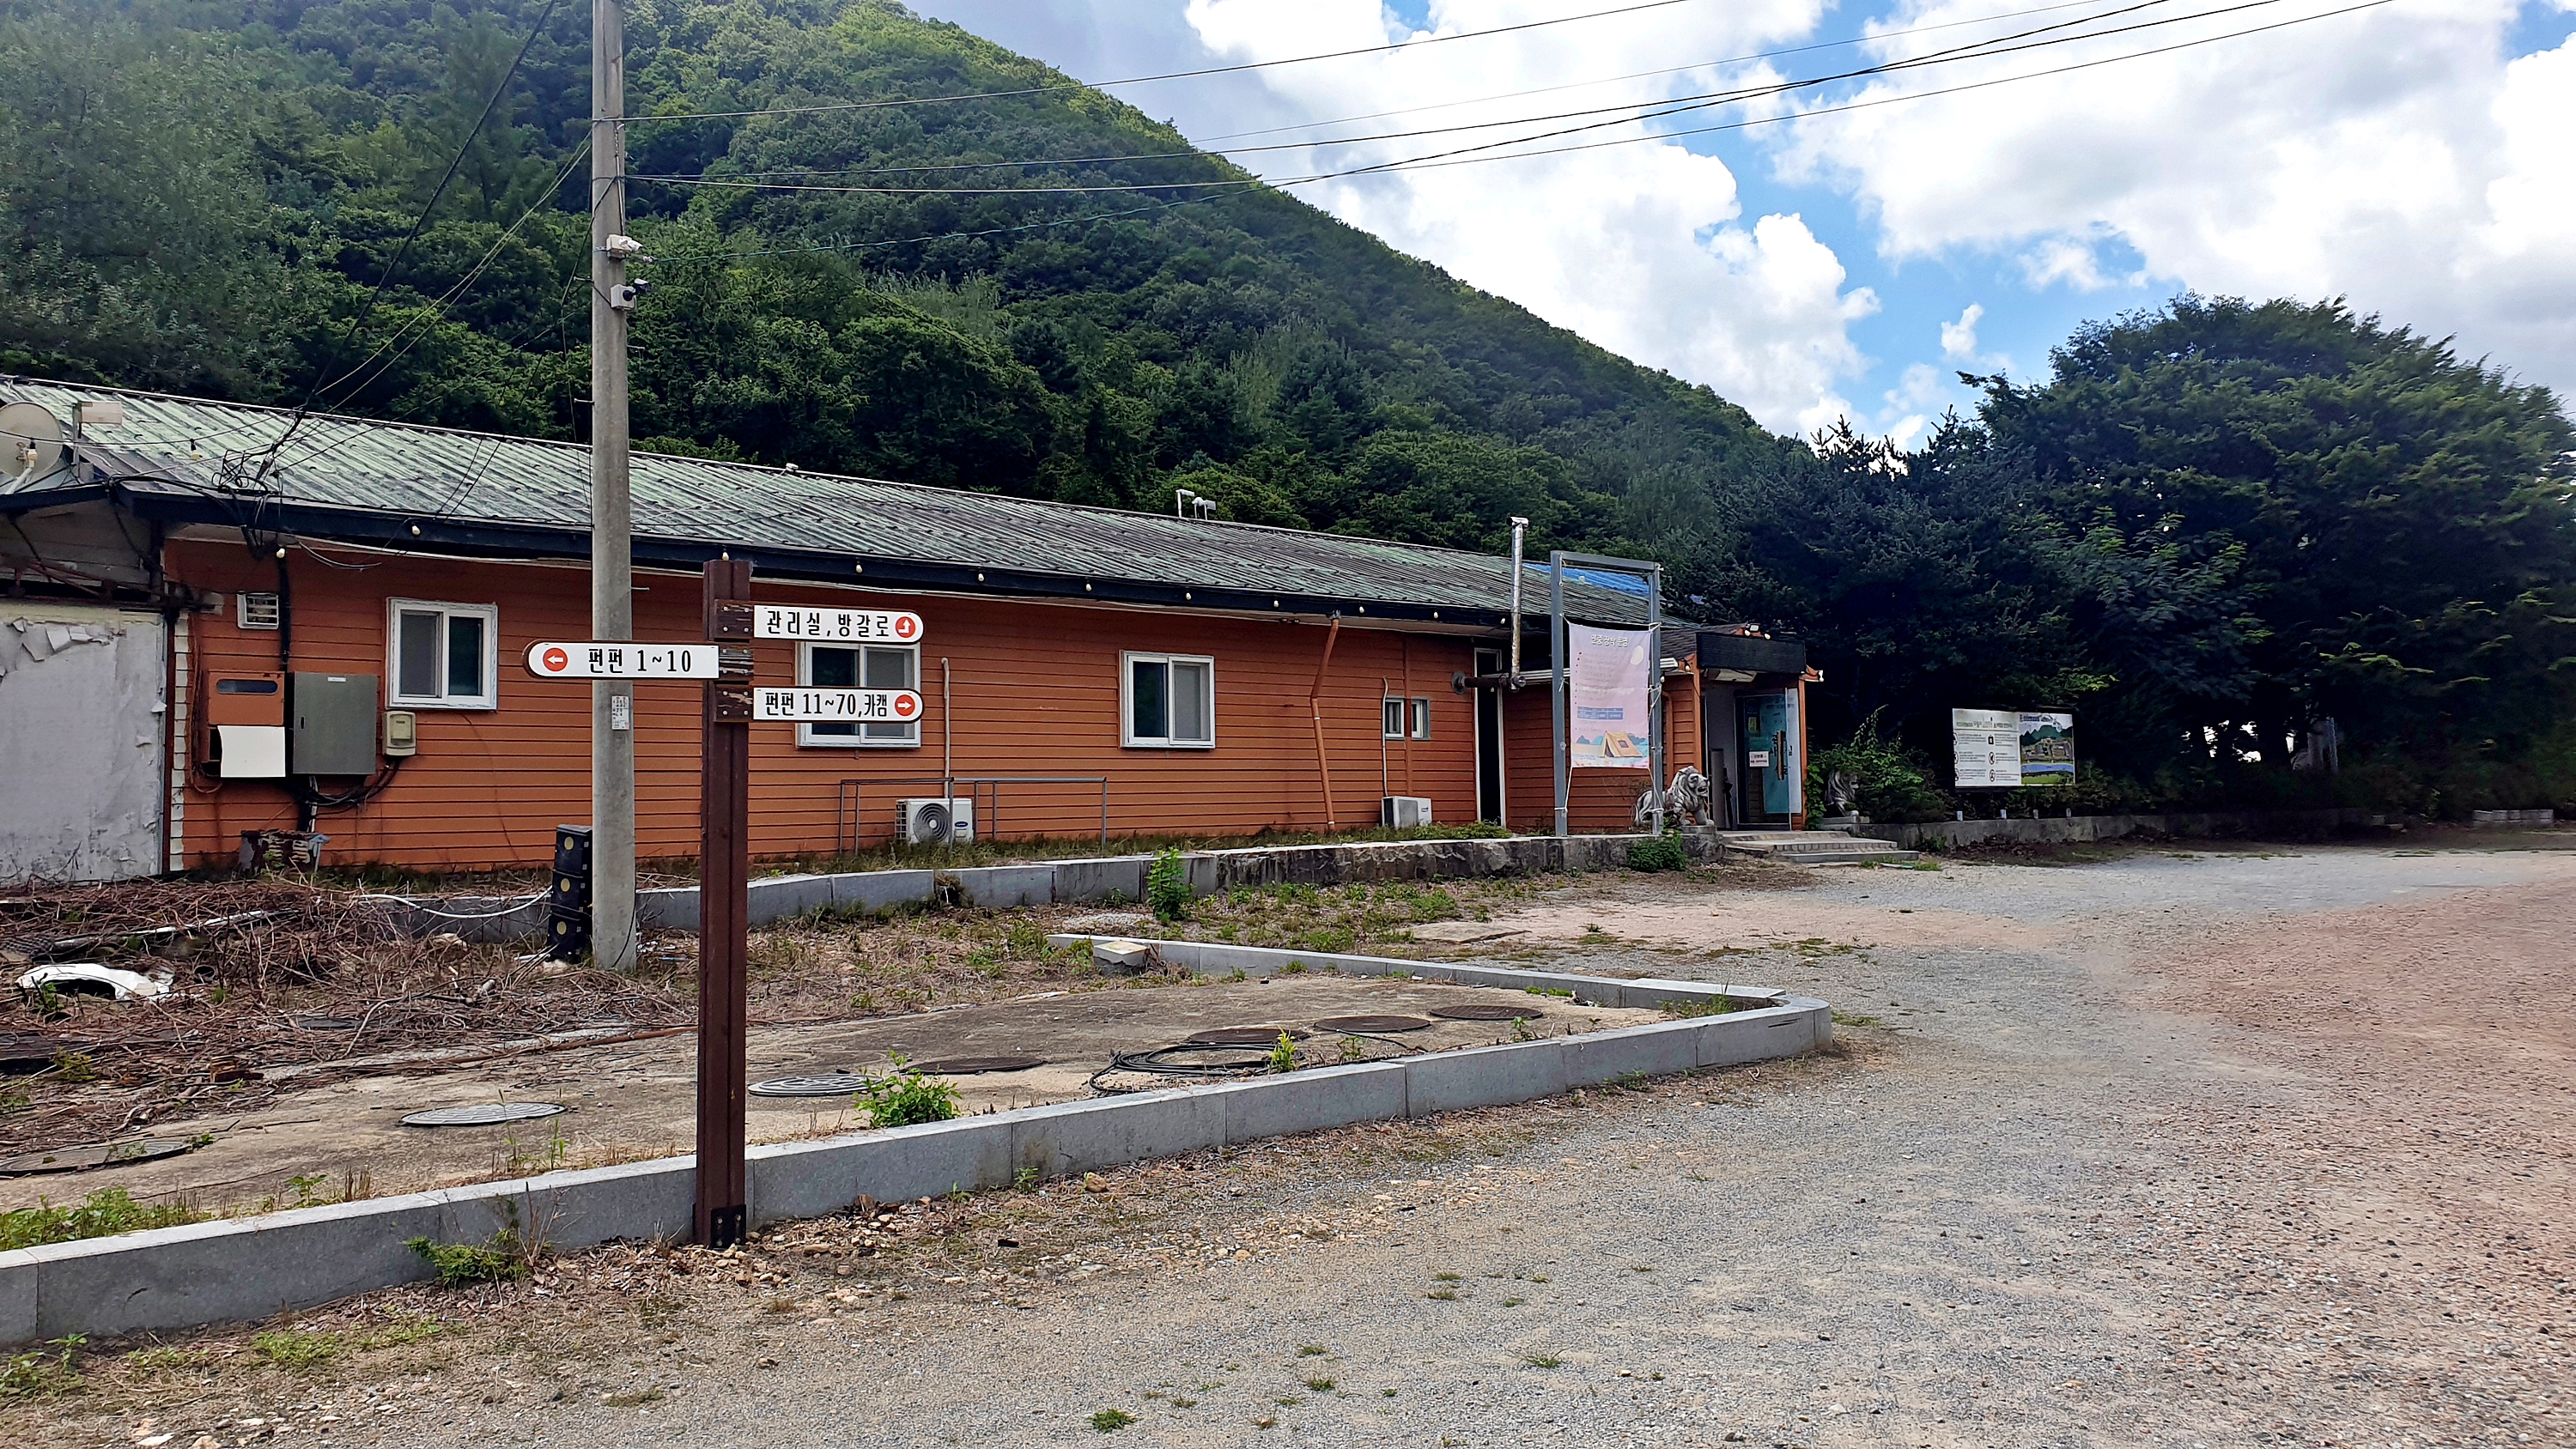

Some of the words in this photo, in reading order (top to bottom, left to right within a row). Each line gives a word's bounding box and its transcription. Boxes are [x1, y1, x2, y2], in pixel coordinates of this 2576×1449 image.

[588, 648, 623, 674] 펀펀
[637, 649, 692, 672] 1~10
[765, 692, 794, 716] 펀펀
